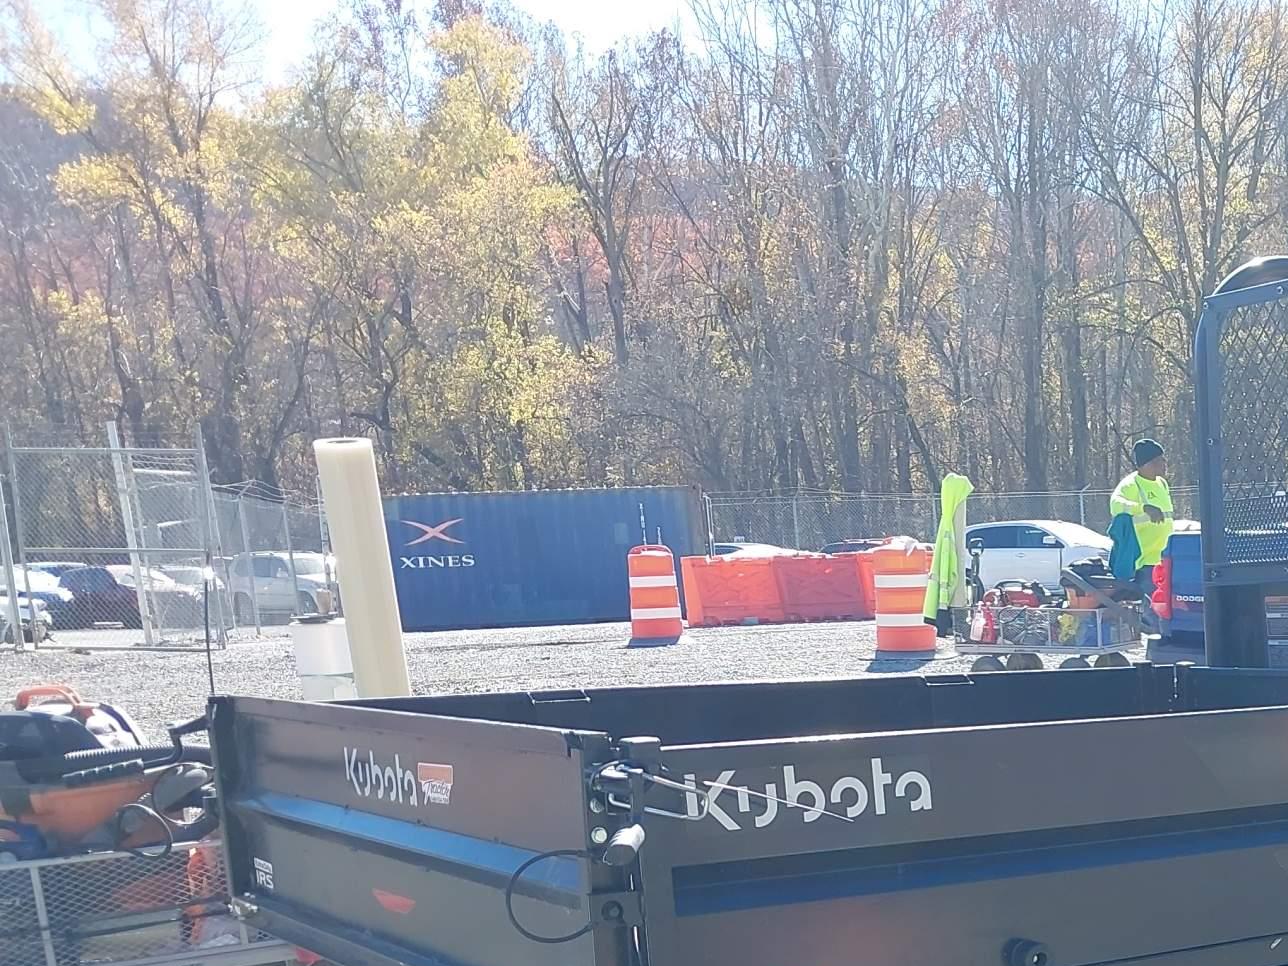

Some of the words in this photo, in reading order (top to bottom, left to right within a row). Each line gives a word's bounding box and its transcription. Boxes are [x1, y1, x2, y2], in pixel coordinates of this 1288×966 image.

[399, 554, 476, 569] XINES
[342, 746, 418, 807] Kubota
[683, 757, 933, 831] Kubota
[255, 869, 274, 889] IRS
